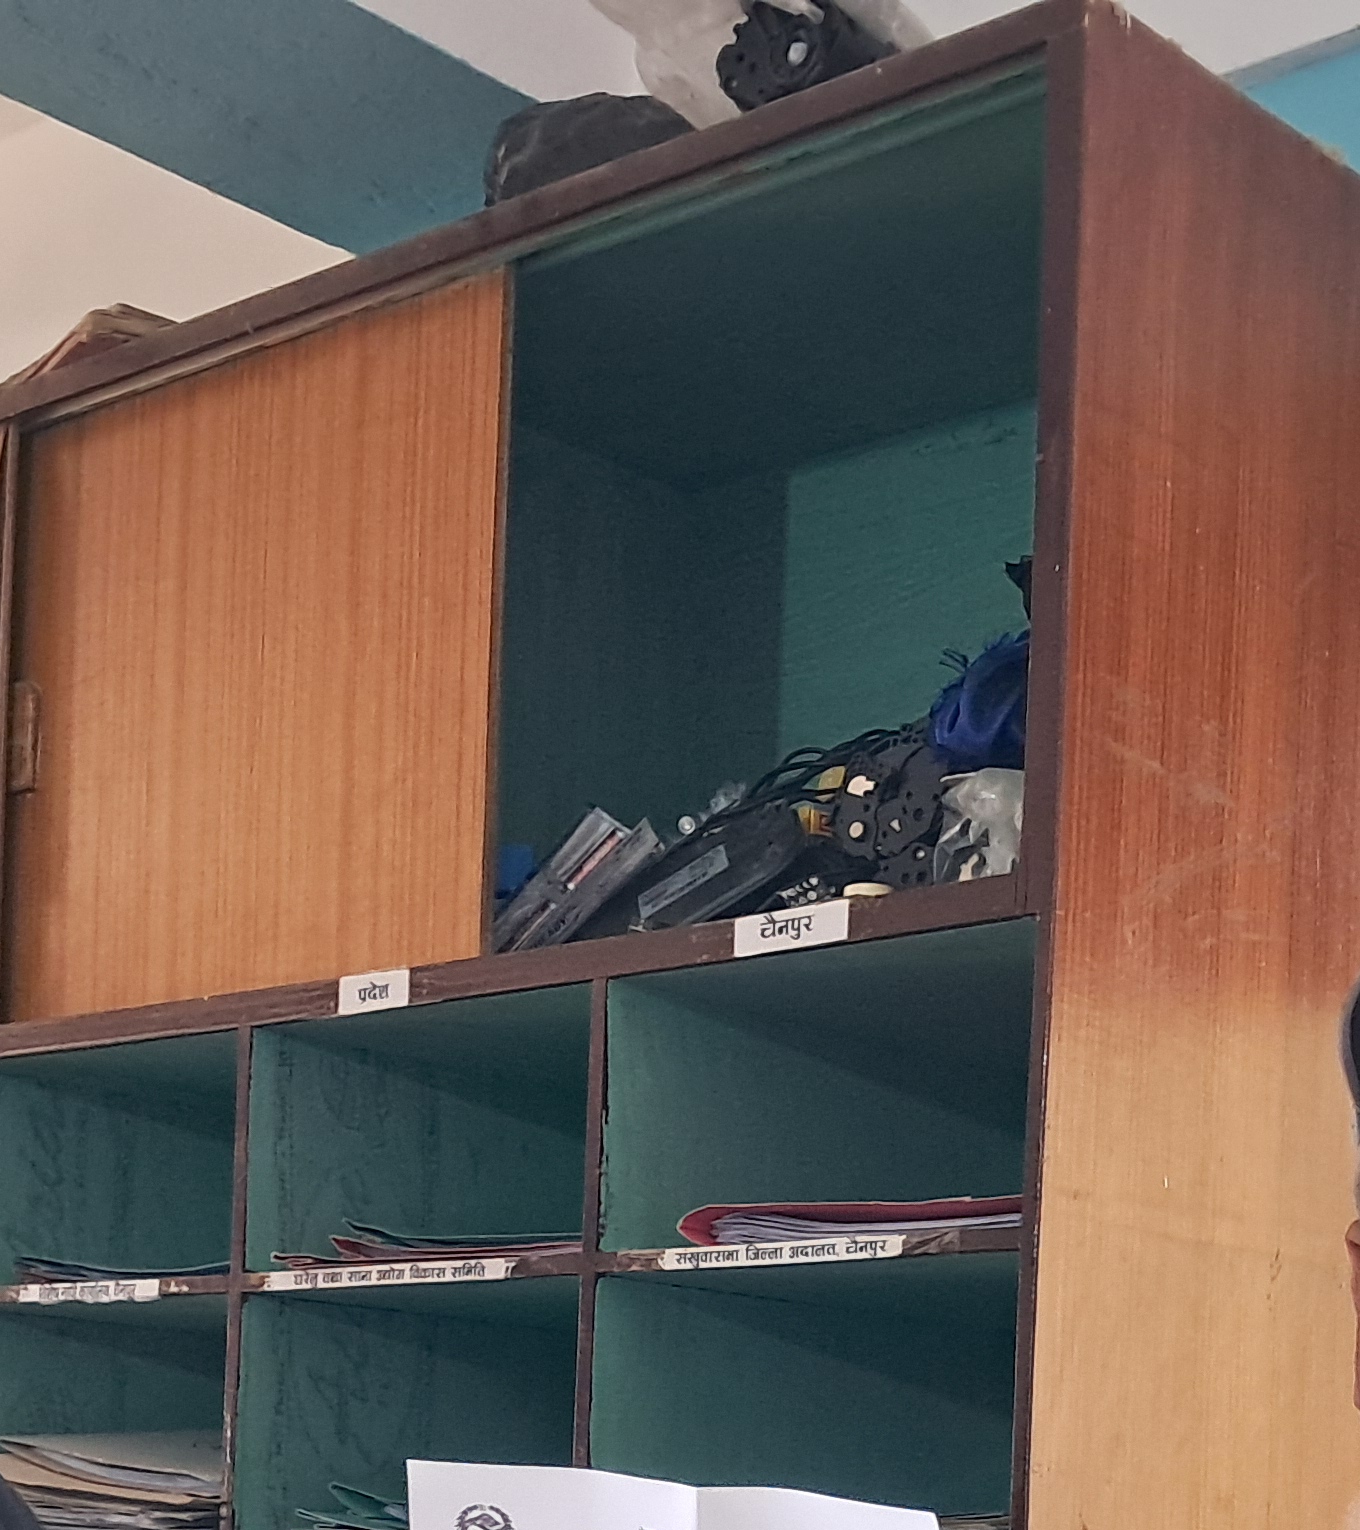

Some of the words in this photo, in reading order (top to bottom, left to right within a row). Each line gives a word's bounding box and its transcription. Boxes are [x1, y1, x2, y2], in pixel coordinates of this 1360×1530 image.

[760, 913, 815, 940] चैनपुर
[358, 981, 390, 1004] प्रदेश
[745, 1243, 783, 1260] जिल्ला
[845, 1237, 888, 1258] चैनपुर
[410, 1264, 446, 1280] विकास
[451, 1262, 487, 1278] समिति
